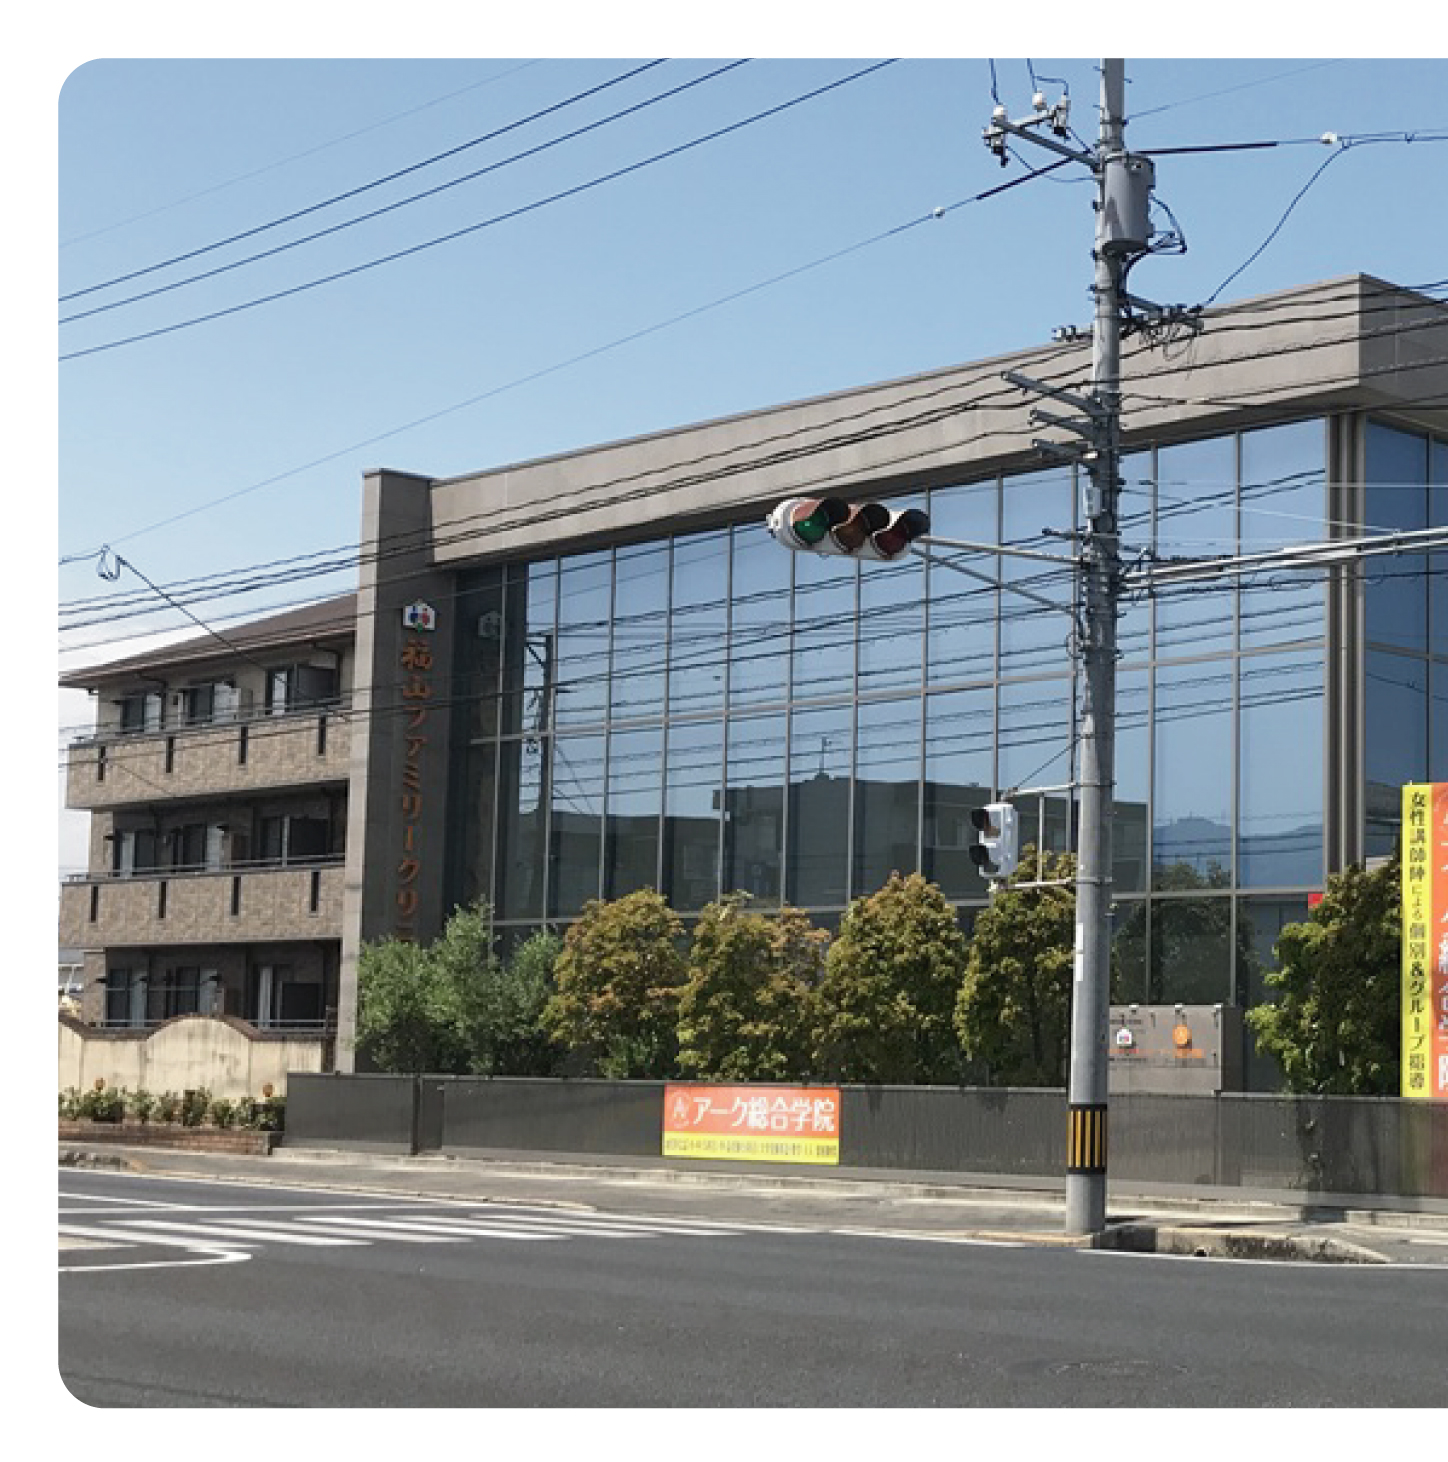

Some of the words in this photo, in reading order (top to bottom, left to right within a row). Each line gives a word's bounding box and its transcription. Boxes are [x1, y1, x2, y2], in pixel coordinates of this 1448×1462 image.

[692, 1096, 835, 1131] アーク総合学院
